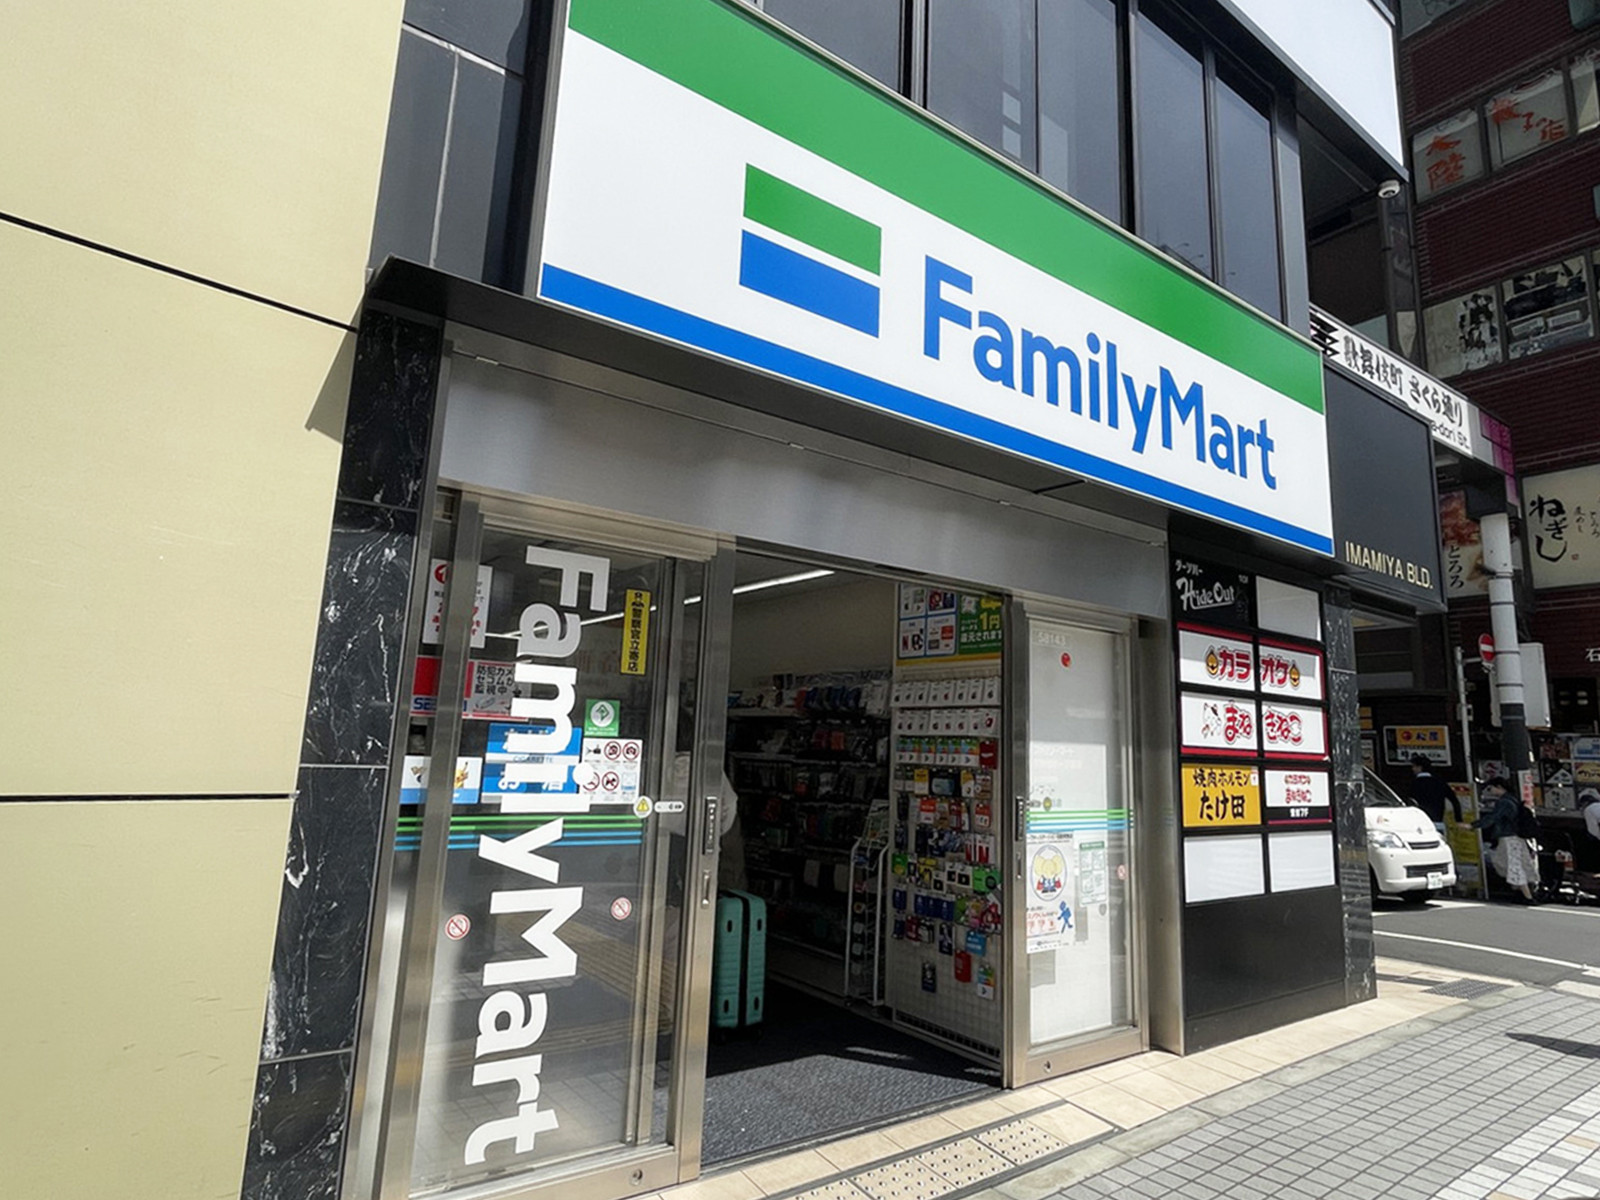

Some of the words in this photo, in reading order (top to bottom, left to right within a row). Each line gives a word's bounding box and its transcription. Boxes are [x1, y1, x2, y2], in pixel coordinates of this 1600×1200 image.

[924, 255, 1277, 490] FamilyMart
[1344, 335, 1404, 396] 歌舞伎町
[1409, 375, 1464, 427] さくら通り
[1529, 494, 1568, 562] ねぎし
[1345, 541, 1404, 578] IMAMIYA
[1407, 562, 1433, 589] BLD.
[1448, 545, 1465, 588] とろろ
[1176, 577, 1214, 611] Hide
[1213, 581, 1235, 603] Out
[1218, 647, 1289, 685] カラオケ
[1225, 705, 1302, 743] まねきねこ
[1193, 767, 1251, 788] 焼肉ホルモン
[1200, 789, 1245, 821] たけ田
[465, 545, 611, 1166] FamilyMart
